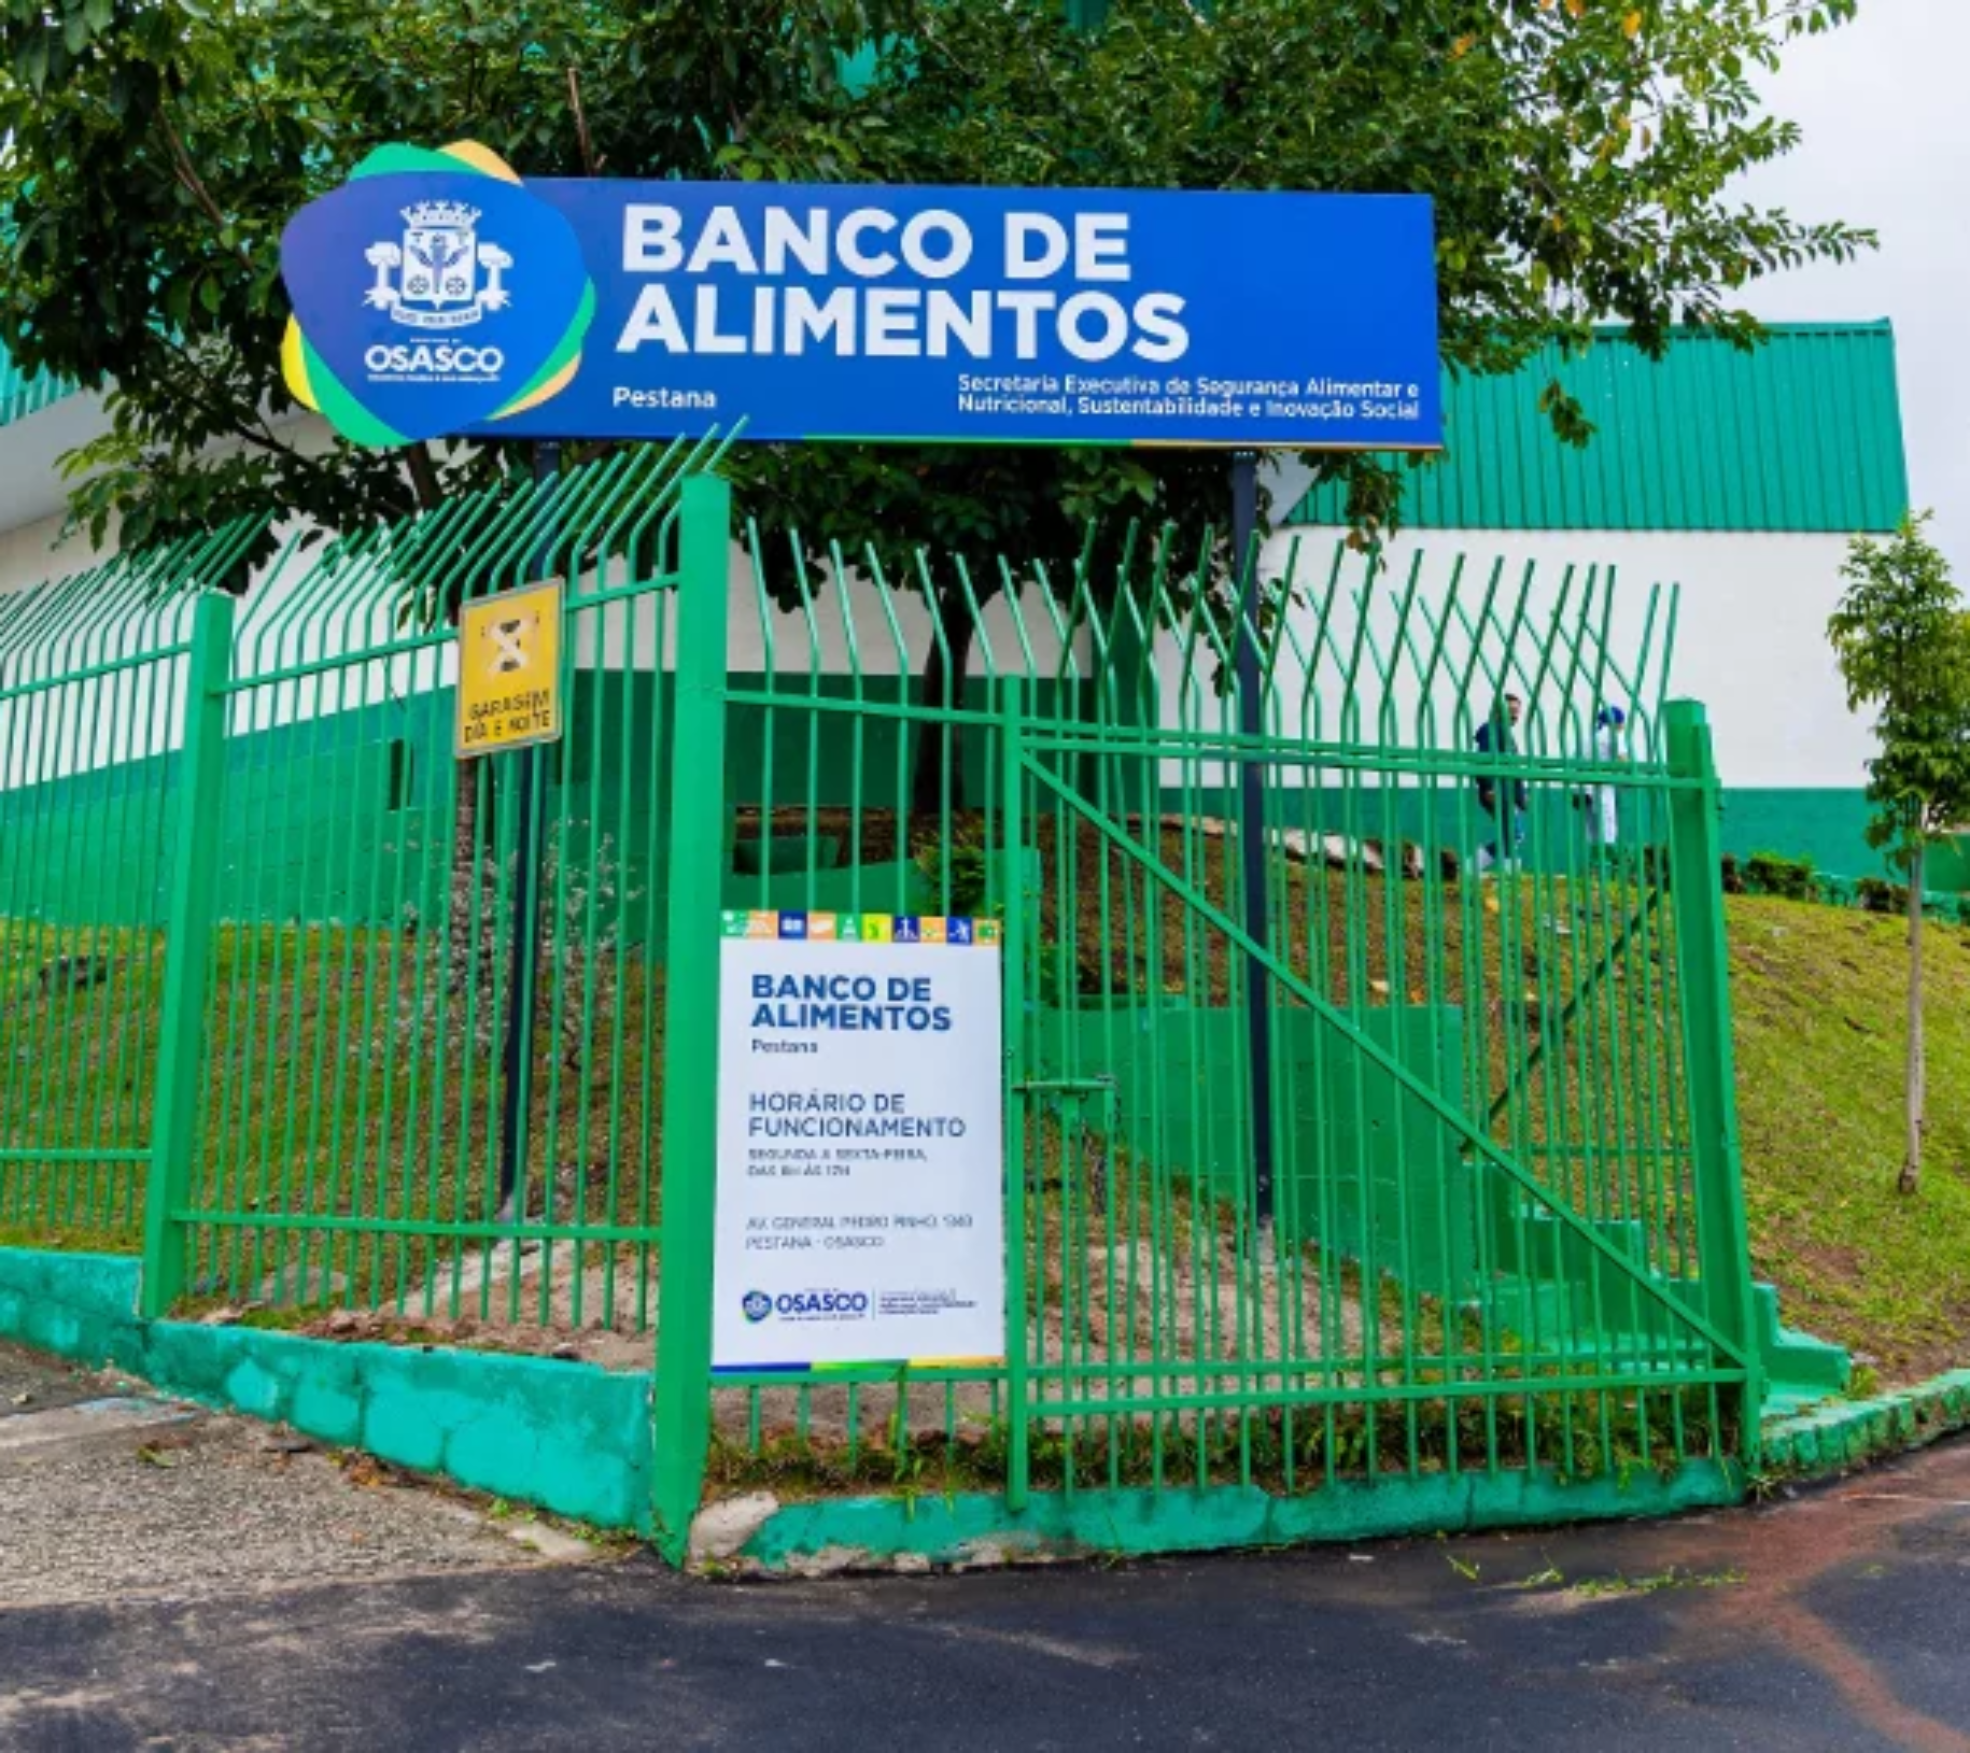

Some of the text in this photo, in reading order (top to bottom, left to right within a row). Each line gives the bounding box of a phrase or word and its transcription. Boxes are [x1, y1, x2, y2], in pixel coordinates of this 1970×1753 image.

[622, 204, 1131, 282] BANCO DE
[615, 284, 1189, 362] ALIMENTOS
[364, 344, 505, 372] OSASCO
[613, 386, 716, 409] Pestana
[958, 374, 1419, 398] Secretaria Executiva de Segurança Alimentar e
[958, 394, 1419, 421] Nutricional, Sustentabilidade e Inovação Social
[751, 974, 932, 1002] BANCO DE
[750, 1003, 952, 1031] ALIMENTOS
[751, 1039, 819, 1053] Pestana
[749, 1088, 906, 1114] HORÁRIO DE
[748, 1116, 966, 1138] FUNCIONAMENTO
[776, 1293, 868, 1315] OSASCO
